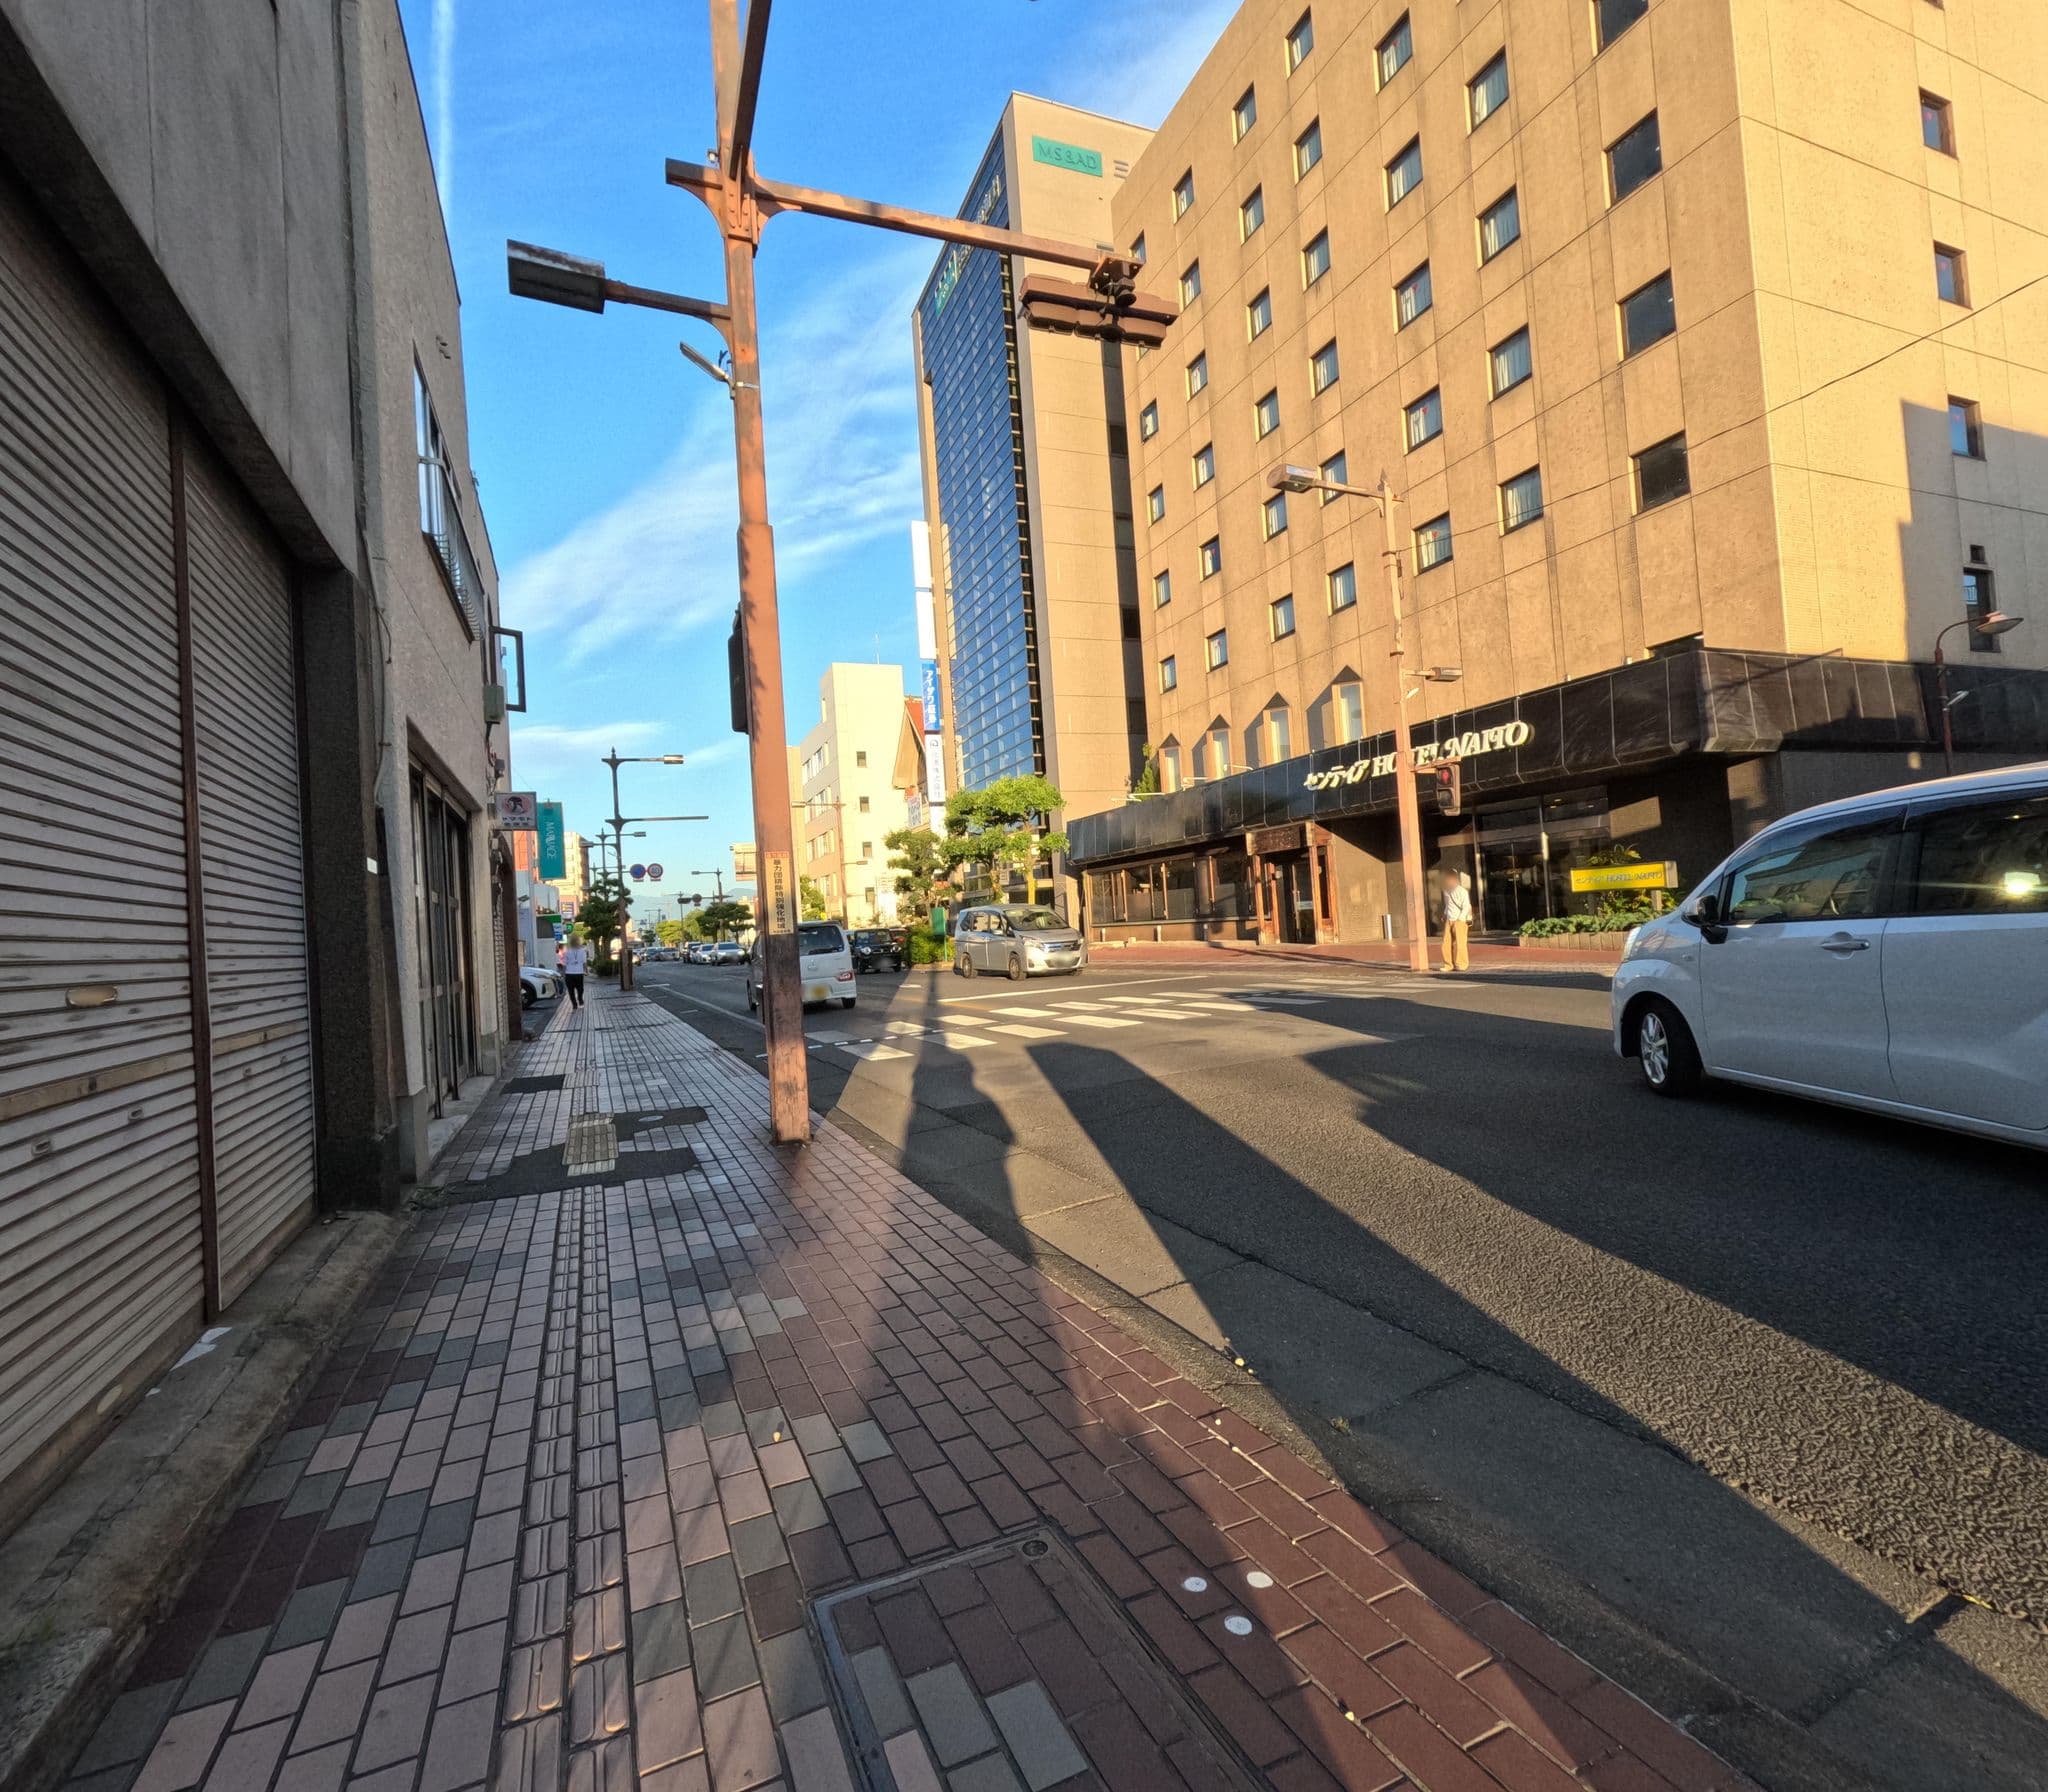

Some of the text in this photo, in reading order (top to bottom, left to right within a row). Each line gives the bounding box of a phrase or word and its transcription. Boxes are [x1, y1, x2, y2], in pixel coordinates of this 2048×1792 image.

[1038, 142, 1097, 170] MS&AD
[1303, 759, 1371, 791] センティア
[1371, 742, 1444, 778] HOEL
